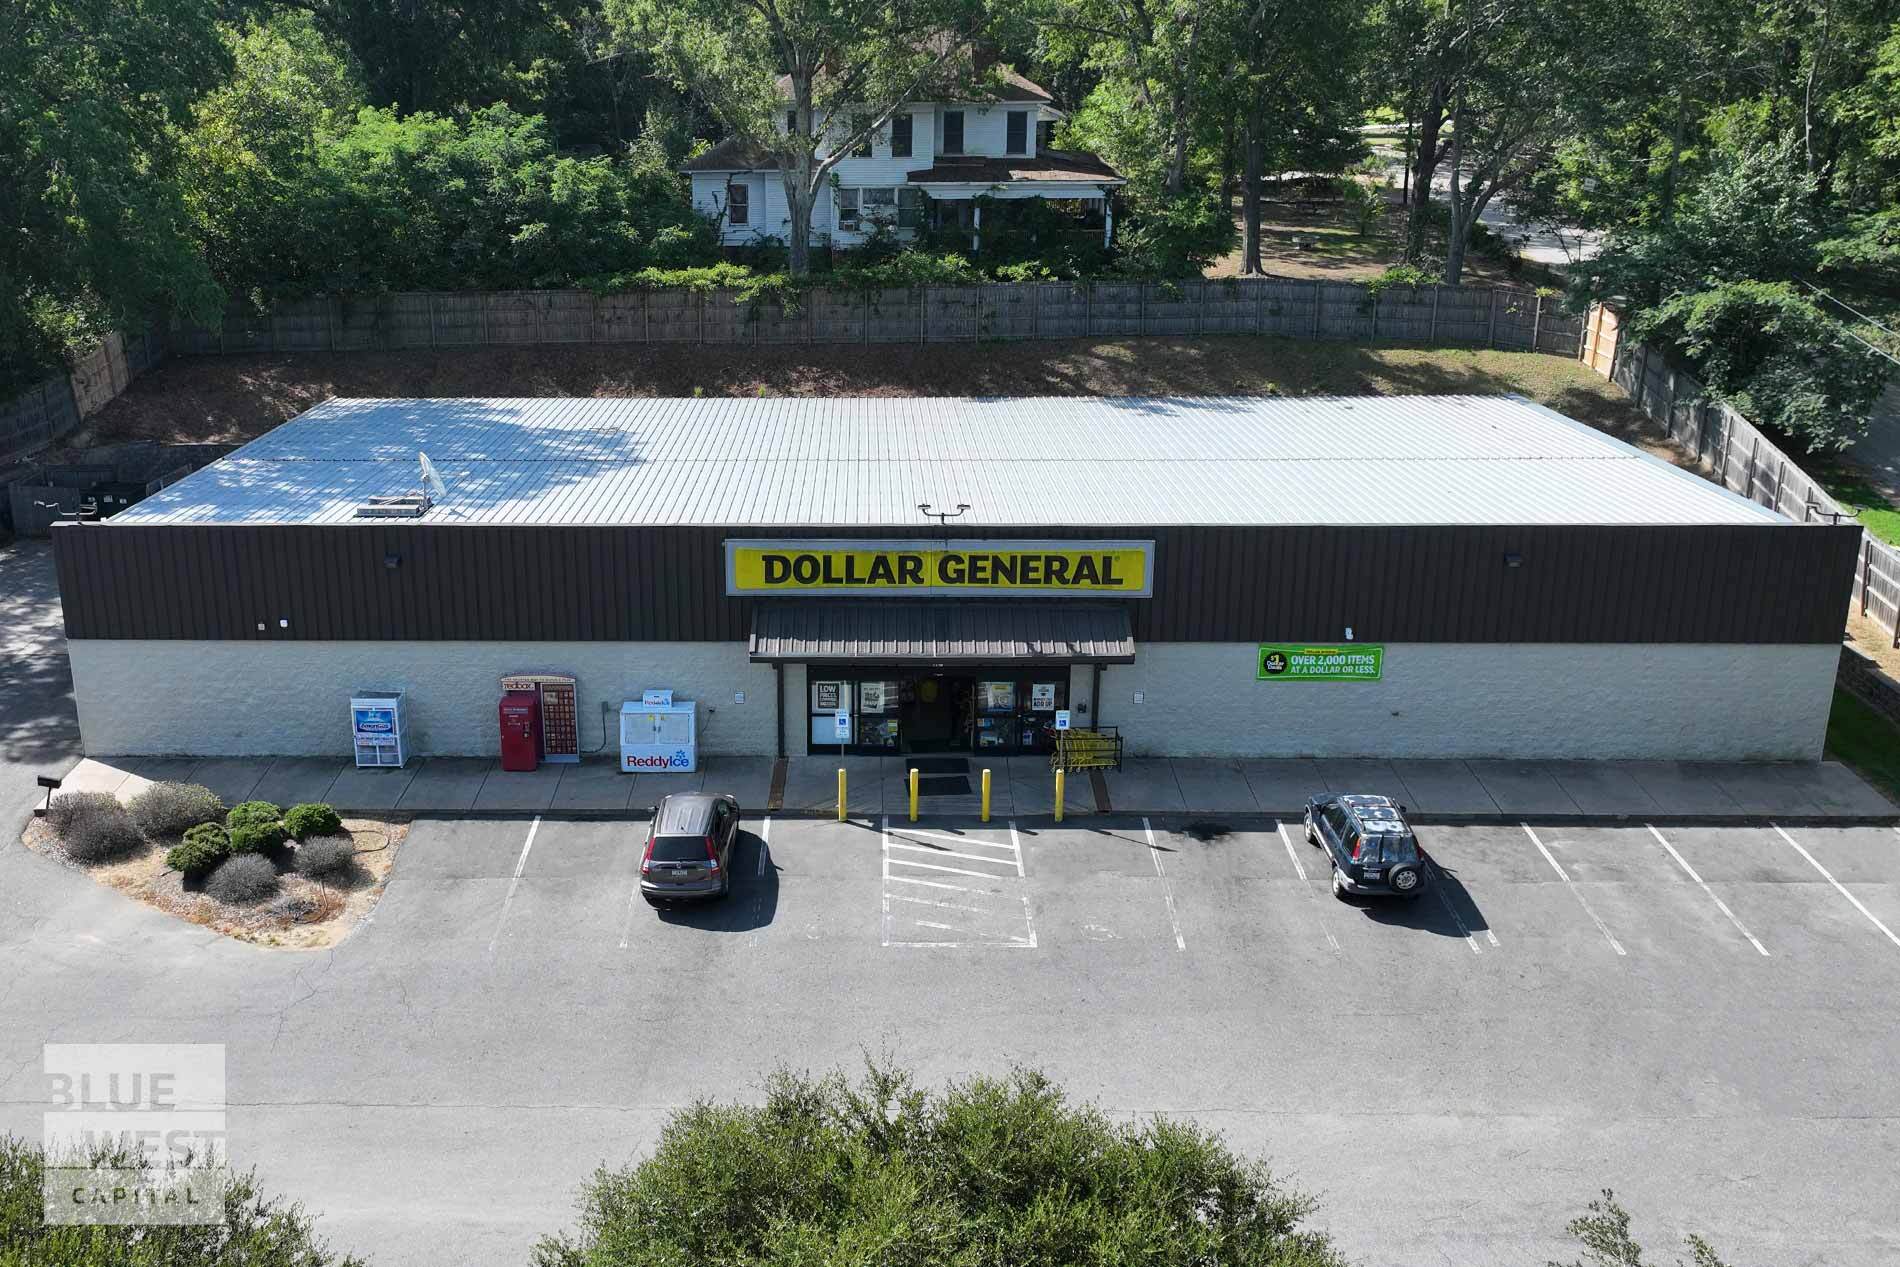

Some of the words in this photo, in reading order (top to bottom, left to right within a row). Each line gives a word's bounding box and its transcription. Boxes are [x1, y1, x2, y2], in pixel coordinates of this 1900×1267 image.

[762, 555, 924, 585] DOLLAR
[938, 554, 1123, 585] GENERAL
[1291, 655, 1315, 665] OVER
[1318, 655, 1345, 666] 2,000
[1348, 655, 1375, 665] ITEMS
[1290, 666, 1300, 674] AT
[1302, 666, 1308, 674] A
[1309, 665, 1340, 674] DOLLAR
[1342, 665, 1354, 673] OR
[819, 685, 836, 693] LOW
